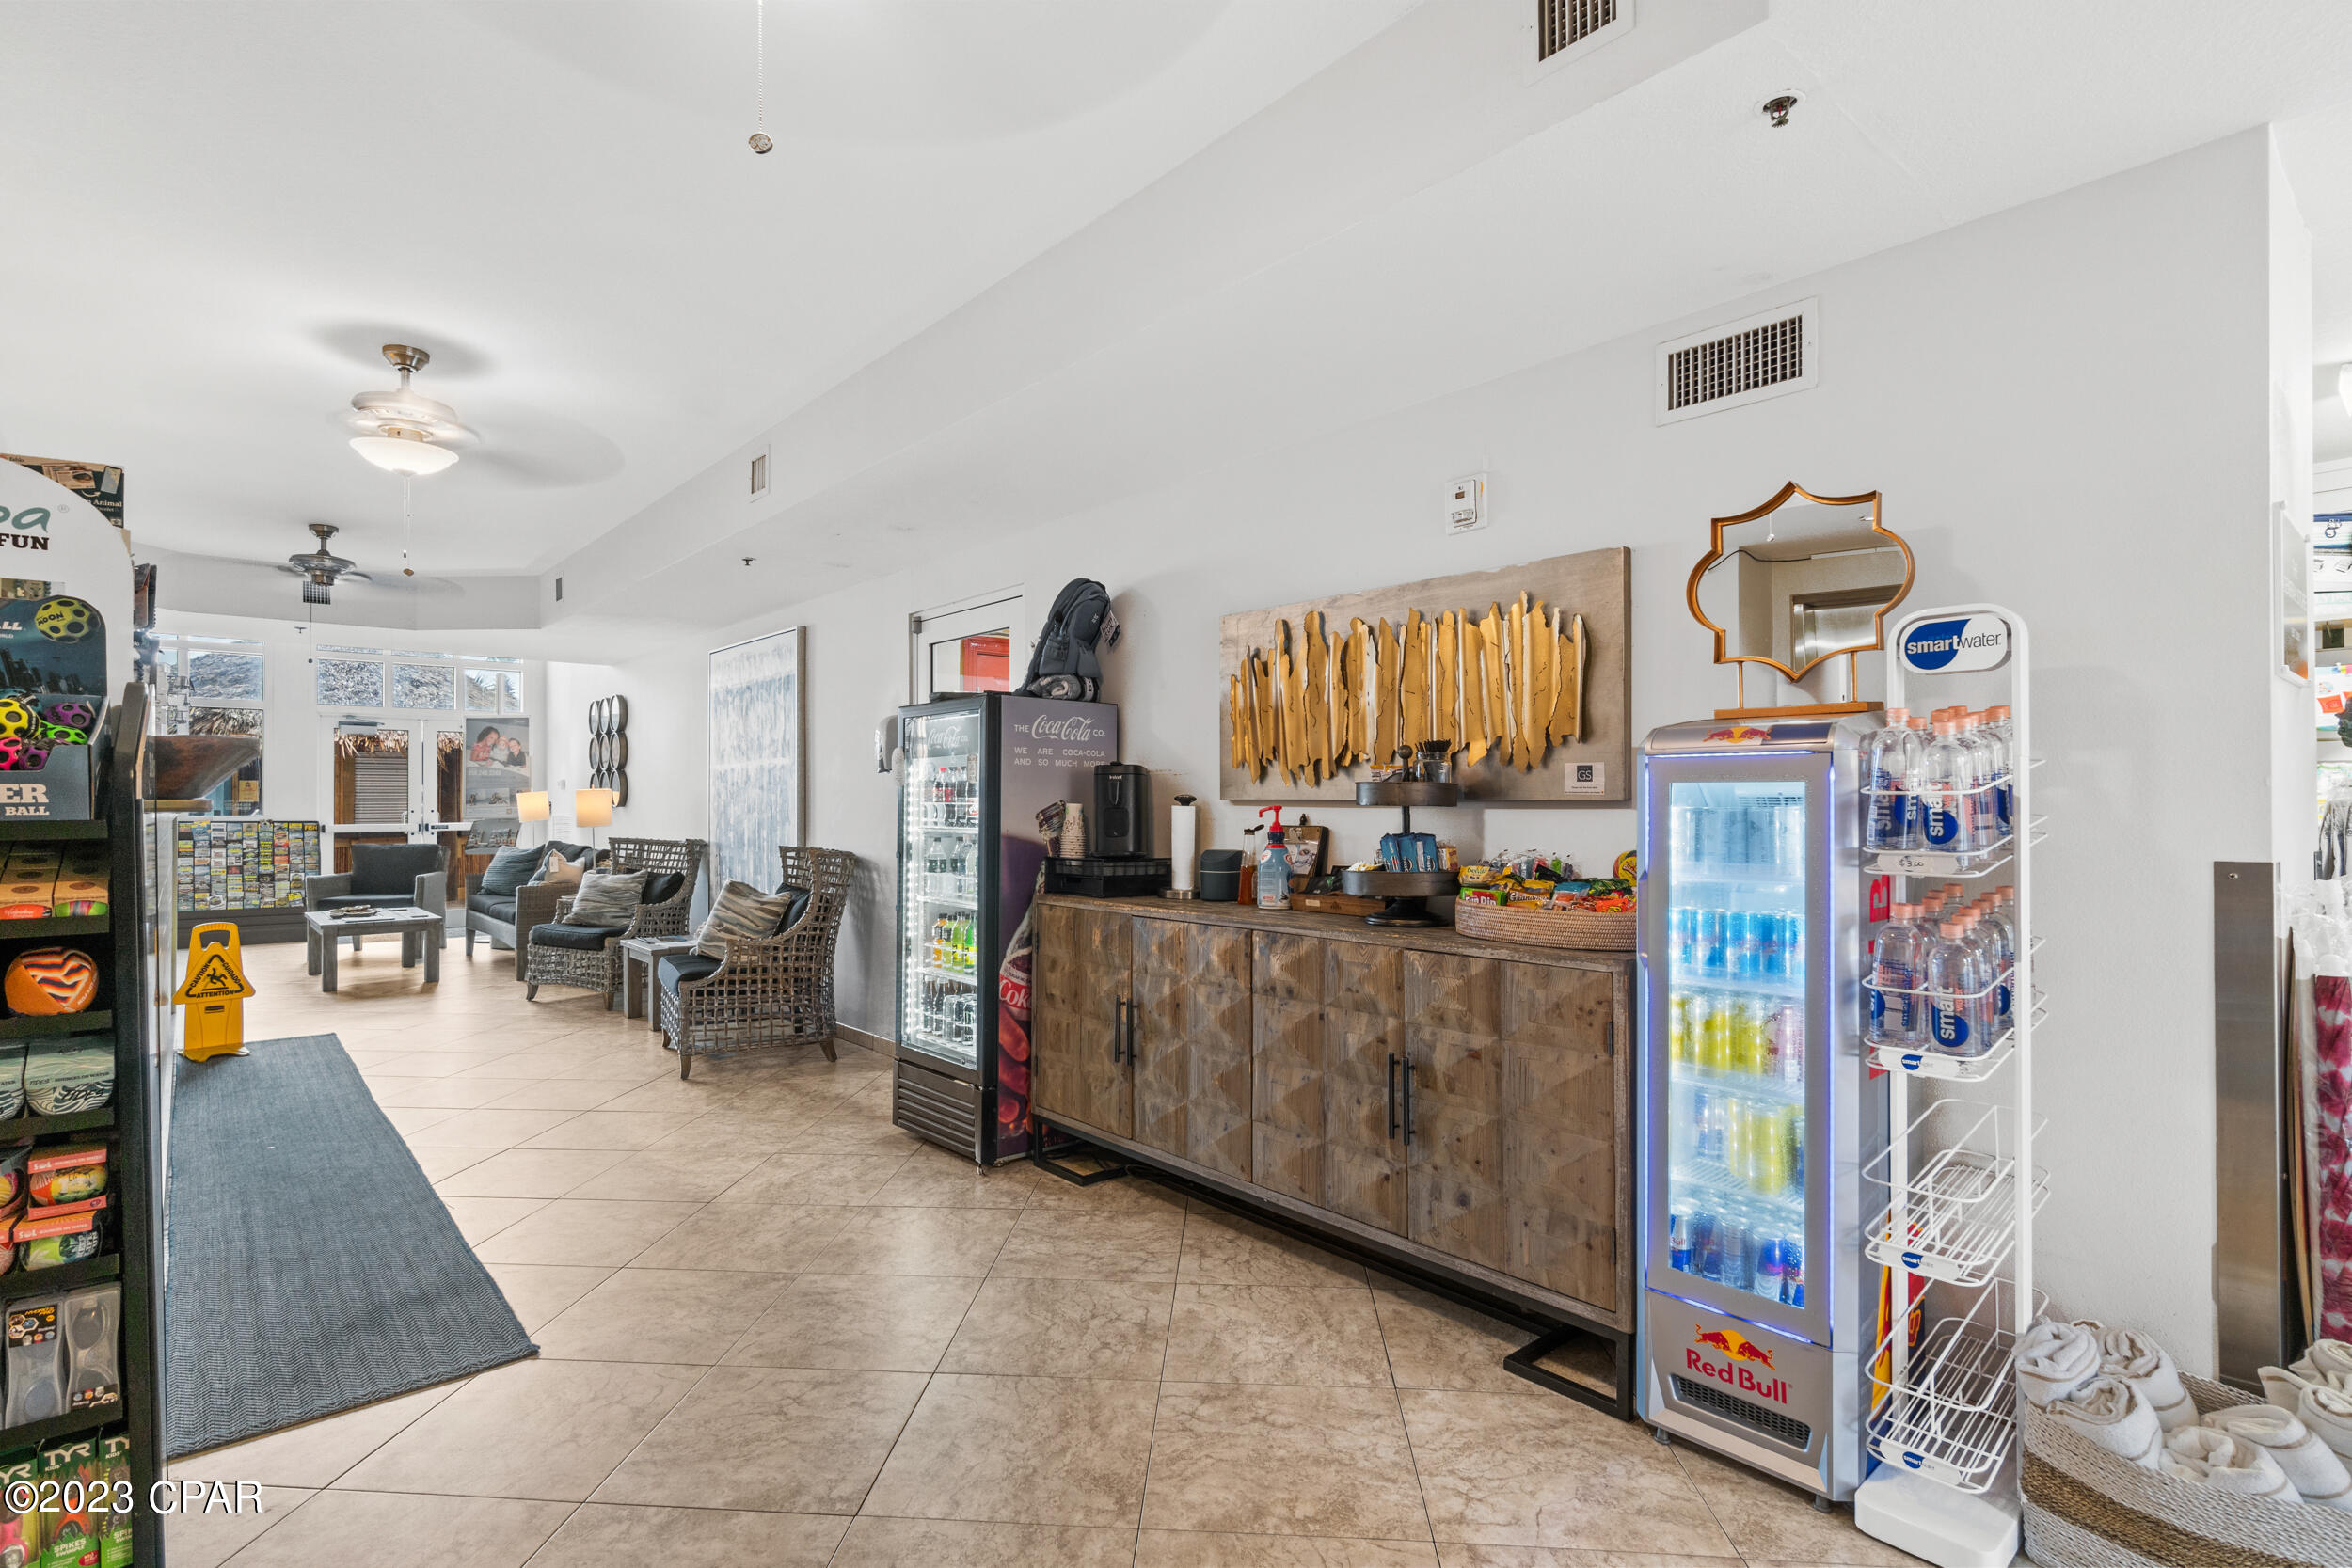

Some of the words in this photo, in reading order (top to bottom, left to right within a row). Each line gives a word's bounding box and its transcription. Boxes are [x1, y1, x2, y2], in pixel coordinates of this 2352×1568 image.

[93, 499, 122, 508] Animal
[38, 611, 64, 626] MOON
[1907, 633, 2002, 654] smartwater
[1014, 724, 1030, 733] THE
[1031, 714, 1095, 741] Coca-Cola
[1092, 729, 1105, 737] CO.
[1038, 748, 1054, 756] ARE
[1062, 748, 1105, 757] COCA-COLA
[1055, 759, 1078, 768] MUCH
[1578, 769, 1593, 781] GS
[5, 805, 50, 816] BALL
[1465, 896, 1480, 905] Fun
[1480, 895, 1497, 905] Dip
[190, 963, 211, 988] CAUTION
[222, 962, 242, 984] CUIDADO
[196, 990, 235, 999] ATTENTION
[1686, 1348, 1734, 1385] Red
[1738, 1366, 1788, 1404] Bull
[44, 1442, 91, 1466] TYR
[54, 1537, 87, 1554] SPIKES
